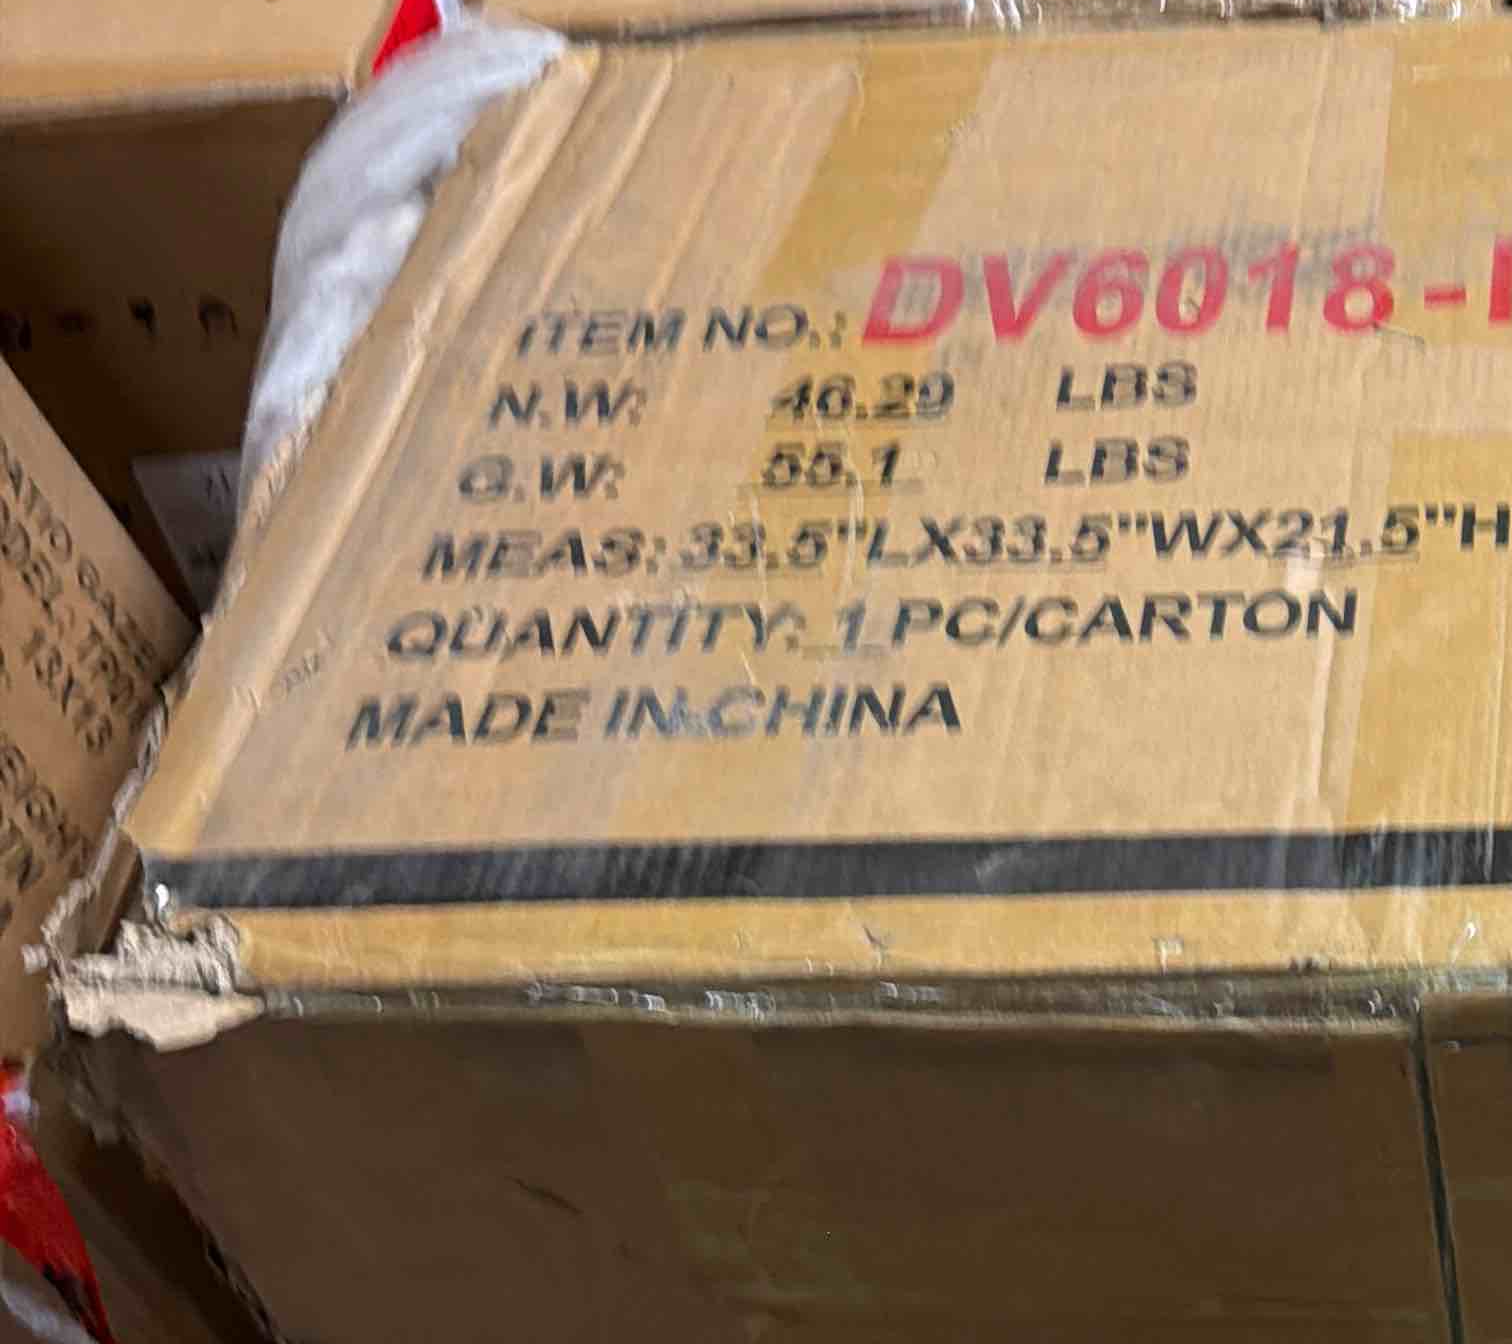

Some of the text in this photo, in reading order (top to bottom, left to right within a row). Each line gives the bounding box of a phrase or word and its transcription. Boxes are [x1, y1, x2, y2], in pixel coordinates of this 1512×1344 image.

[514, 306, 688, 356] ITEM
[771, 369, 956, 423] 46.29
[1054, 360, 1199, 414] LBS
[760, 439, 904, 491] 55.1
[1044, 434, 1192, 490] LBS
[891, 585, 1358, 654] PC/CARTON
[345, 686, 591, 754] MADE
[701, 679, 962, 741] CHINA
